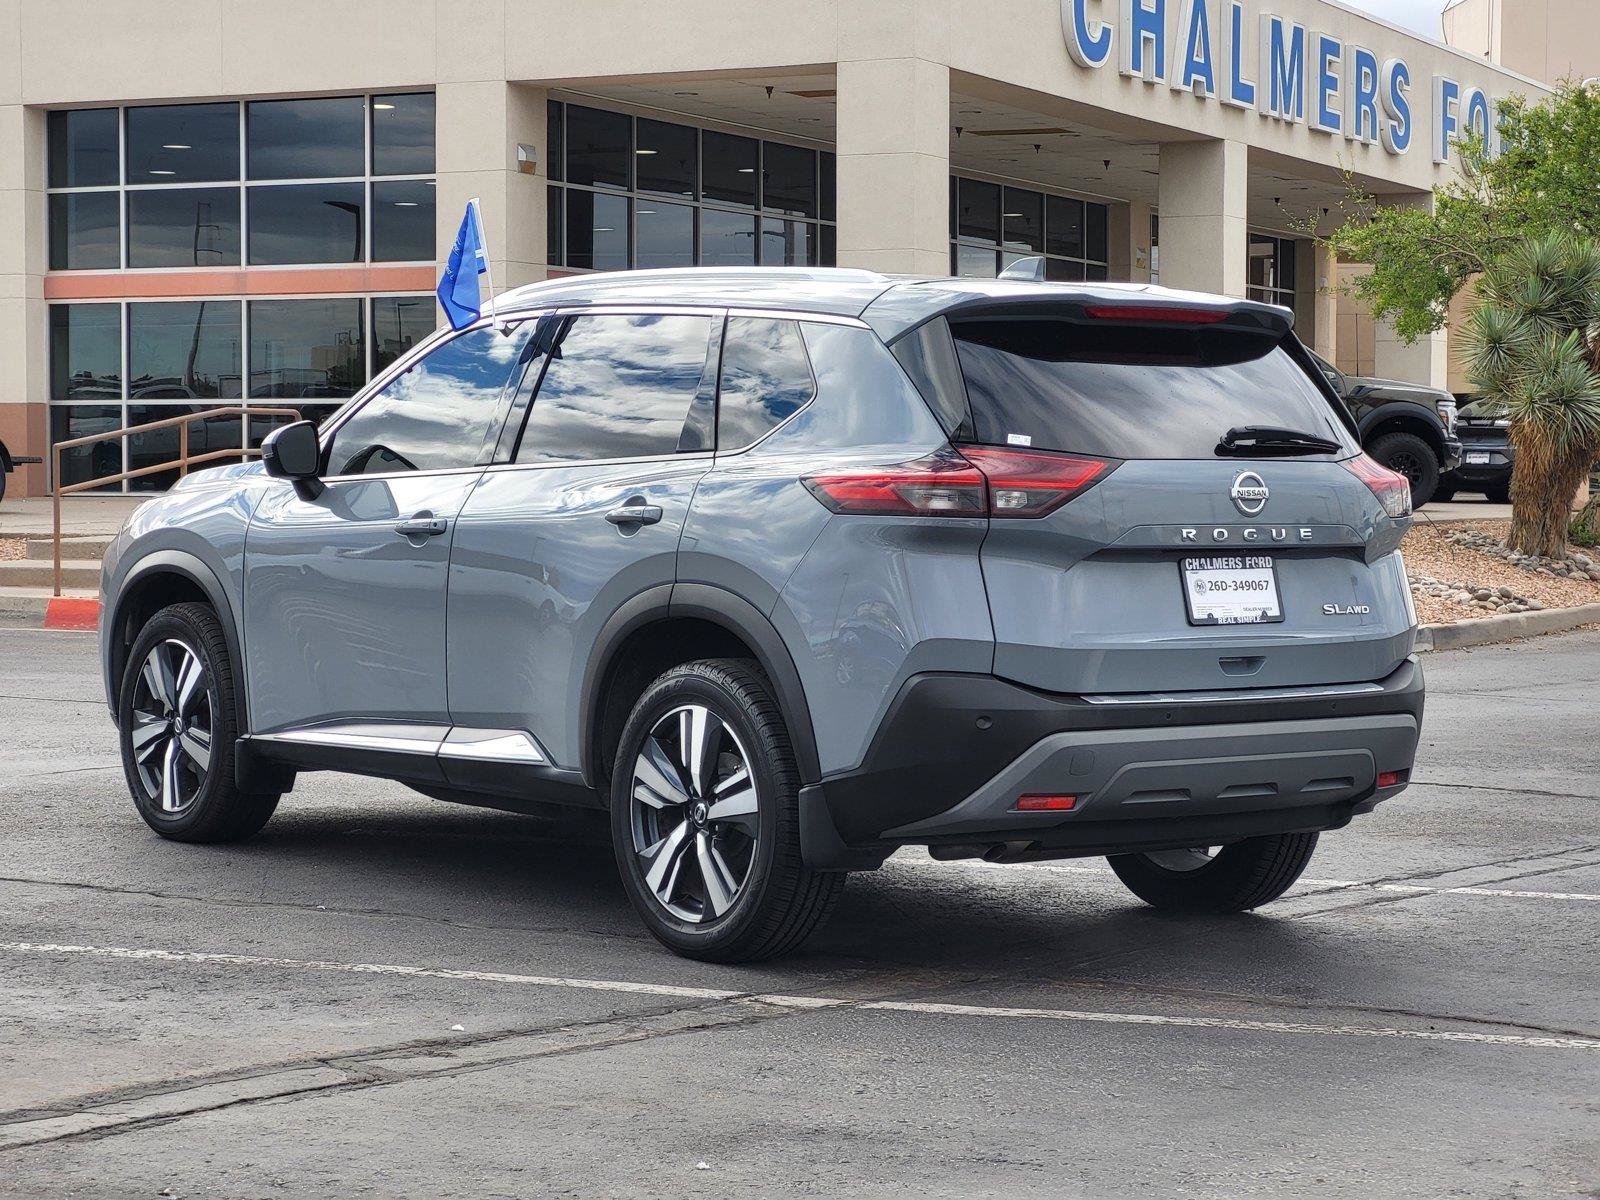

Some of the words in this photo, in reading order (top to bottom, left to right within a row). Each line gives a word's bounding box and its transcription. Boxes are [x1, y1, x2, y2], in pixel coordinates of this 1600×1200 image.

[1061, 0, 1412, 155] CHALMERS
[1432, 74, 1516, 178] FO
[1237, 489, 1267, 497] NISSAN
[1181, 528, 1313, 541] ROGUE
[1185, 558, 1243, 570] CHALMERS
[1245, 556, 1273, 568] FORD
[1207, 580, 1270, 591] 26D-349067
